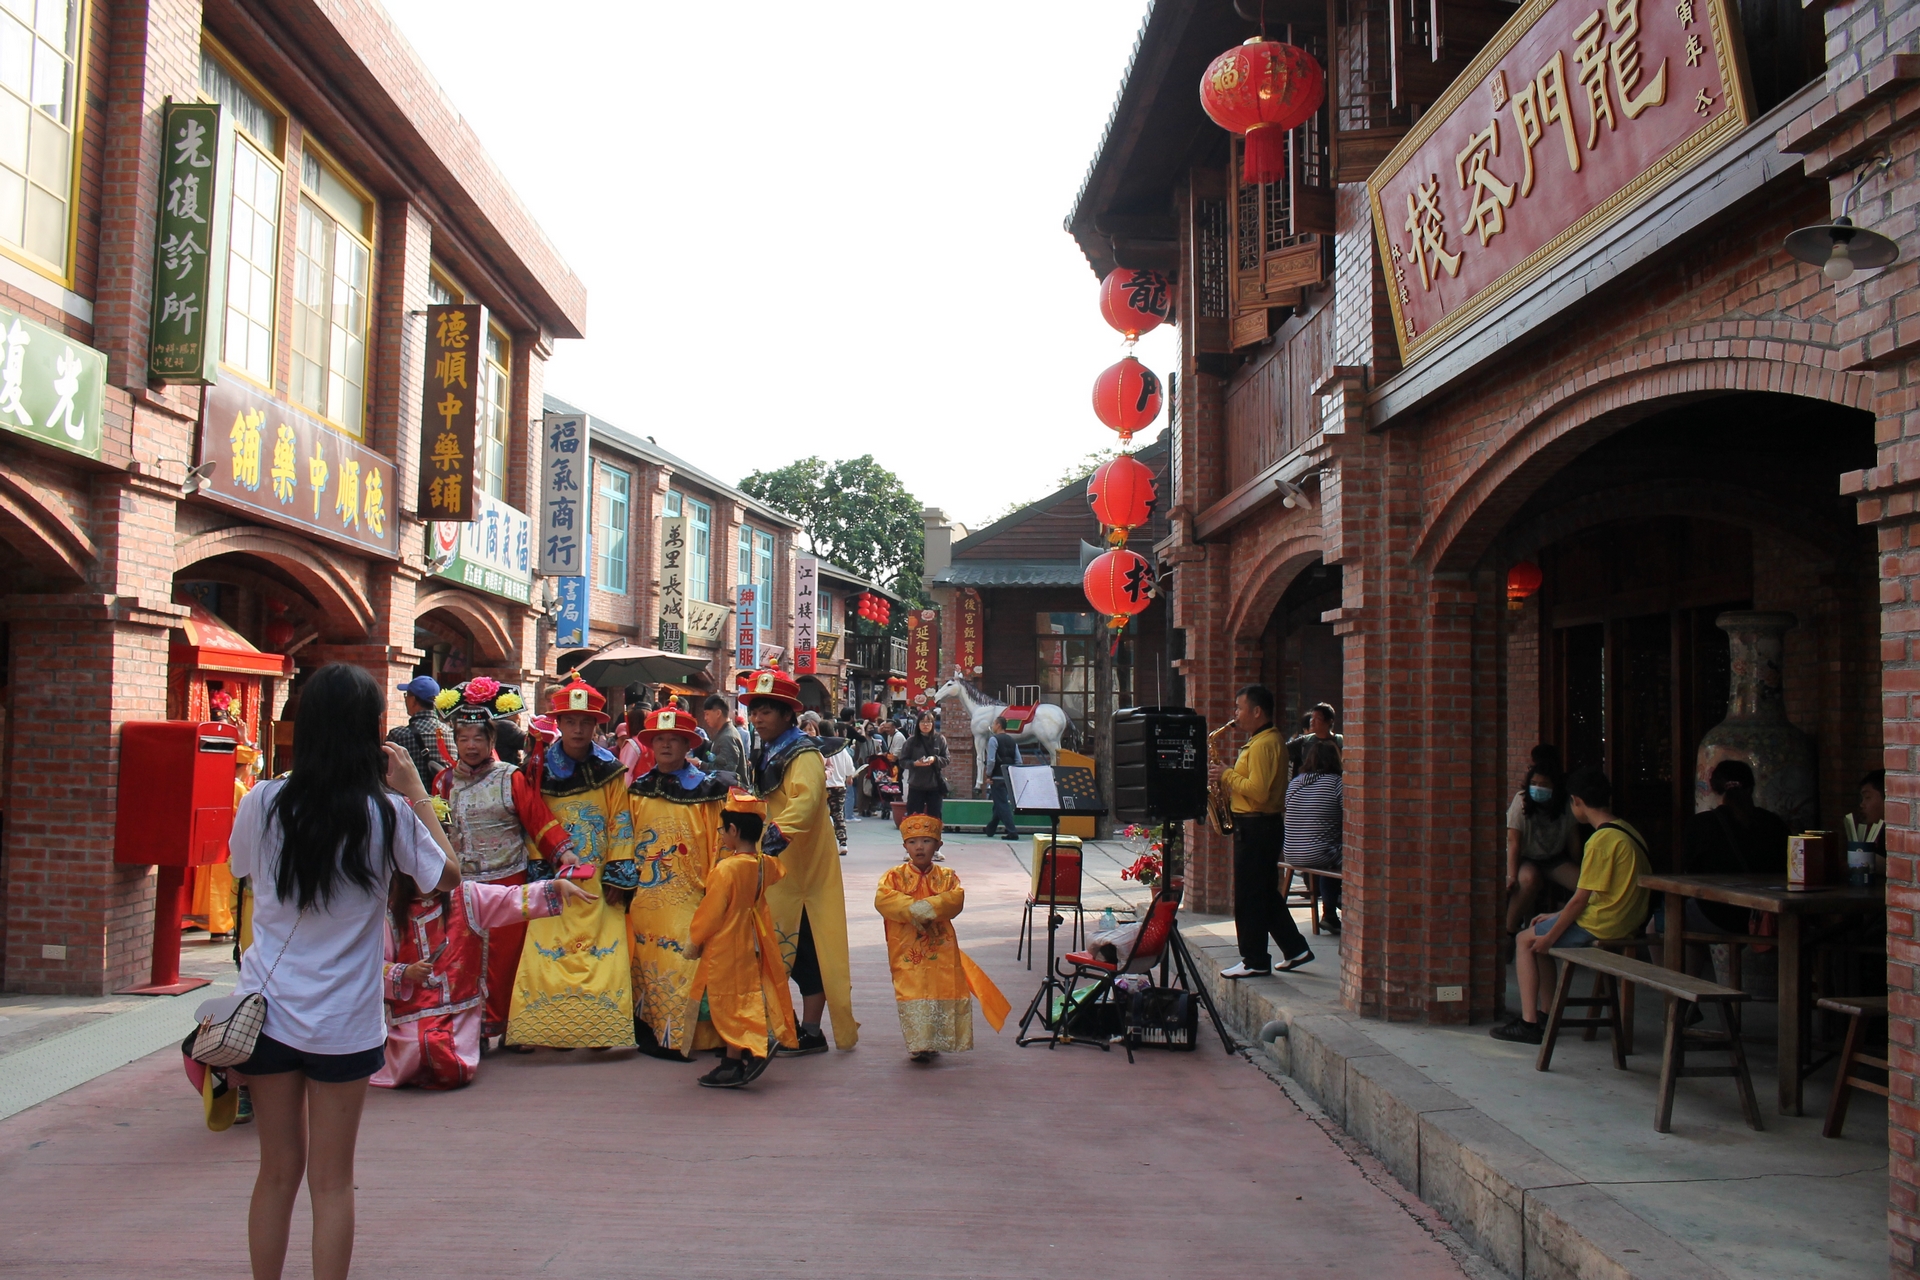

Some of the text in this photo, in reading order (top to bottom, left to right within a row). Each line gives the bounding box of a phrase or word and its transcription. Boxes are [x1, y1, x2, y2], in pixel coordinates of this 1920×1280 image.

[1211, 56, 1239, 91] 福
[1404, 0, 1668, 292] 龍門客棧
[160, 118, 211, 336] 光復診所
[547, 420, 580, 566] 福氣商行
[563, 576, 580, 622] 書局
[662, 524, 684, 619] 萬里長城
[739, 588, 755, 666] 紳士西服
[914, 625, 929, 689] 延禧攻略
